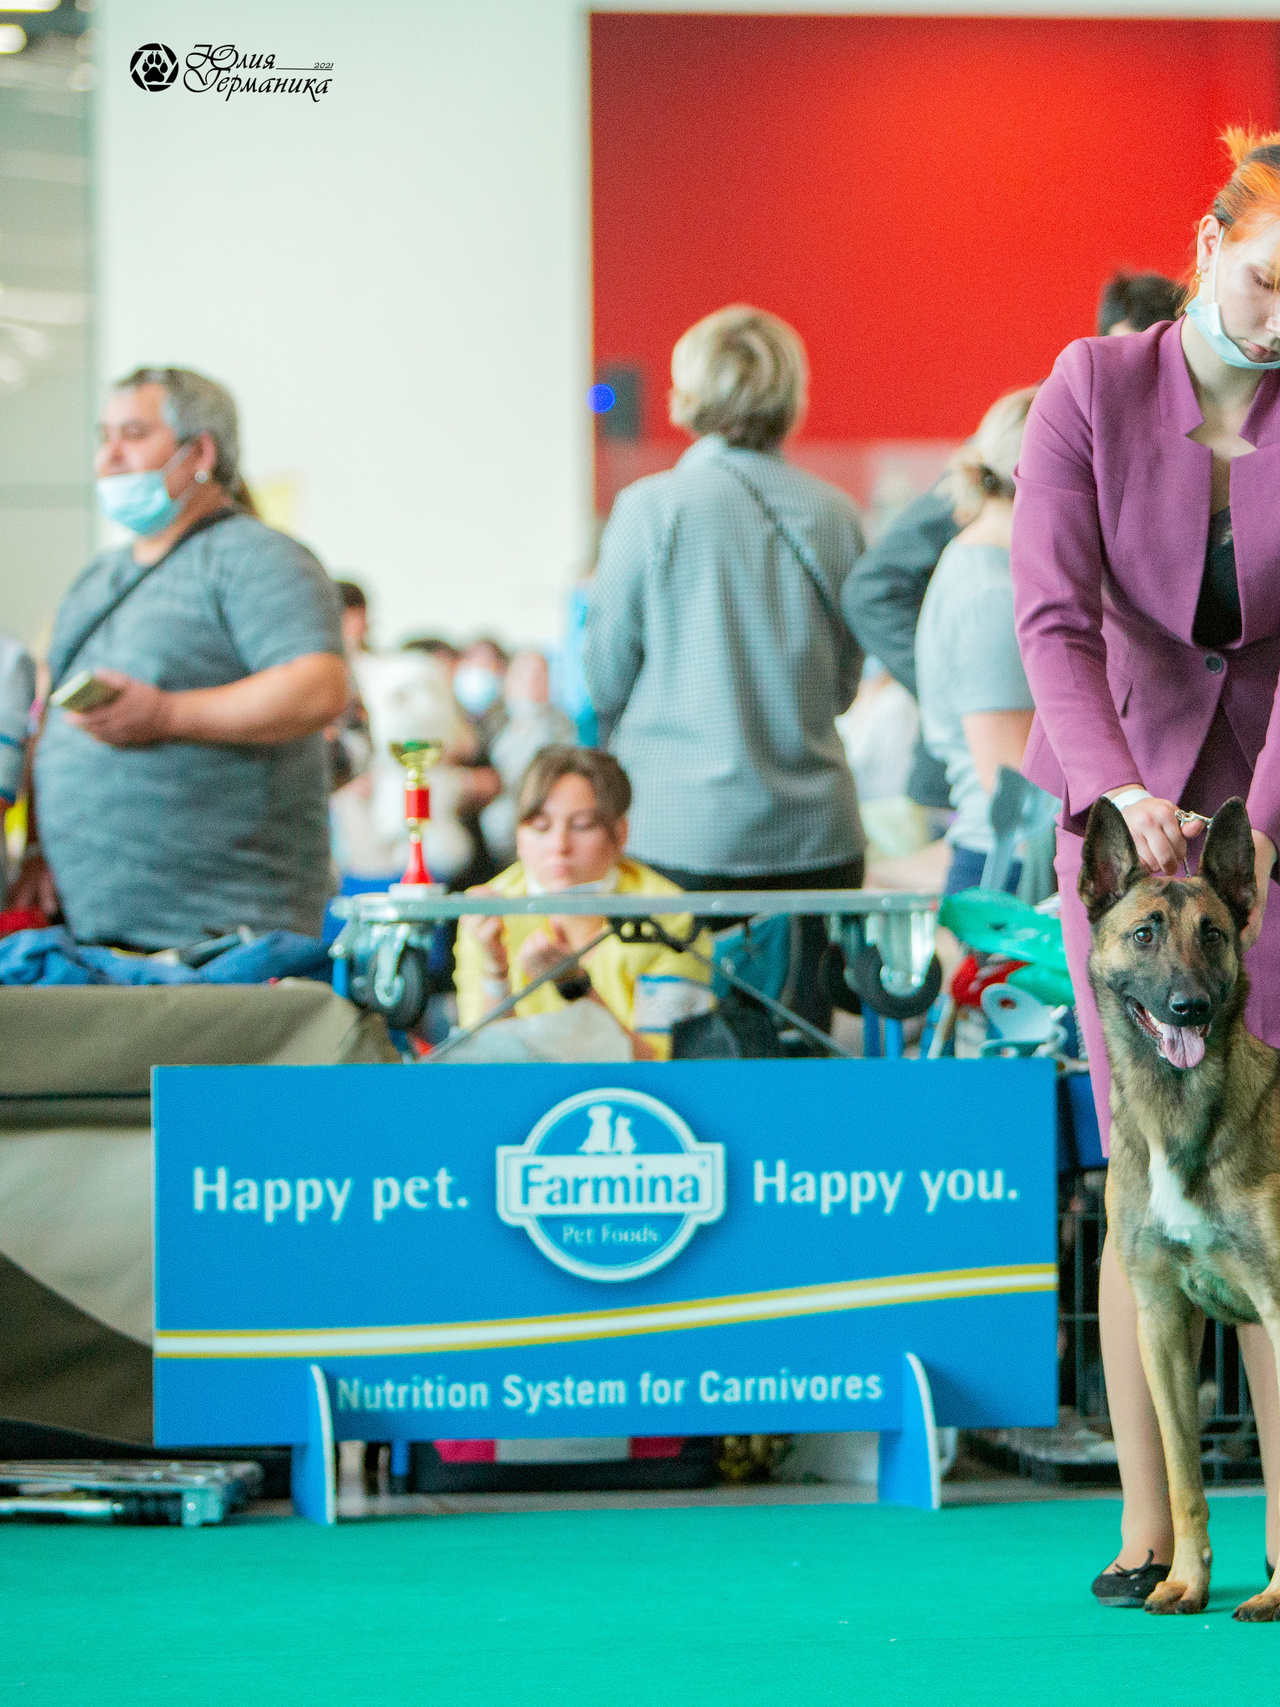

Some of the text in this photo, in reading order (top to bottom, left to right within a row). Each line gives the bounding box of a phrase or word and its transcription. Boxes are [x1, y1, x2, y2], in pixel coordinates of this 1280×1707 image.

[193, 1166, 470, 1223] Happy pet.
[521, 1163, 700, 1206] Farmina
[753, 1160, 1019, 1215] Happy you.
[563, 1222, 660, 1244] Pet Foods
[337, 1367, 883, 1415] Nutrition System for Carnivores
